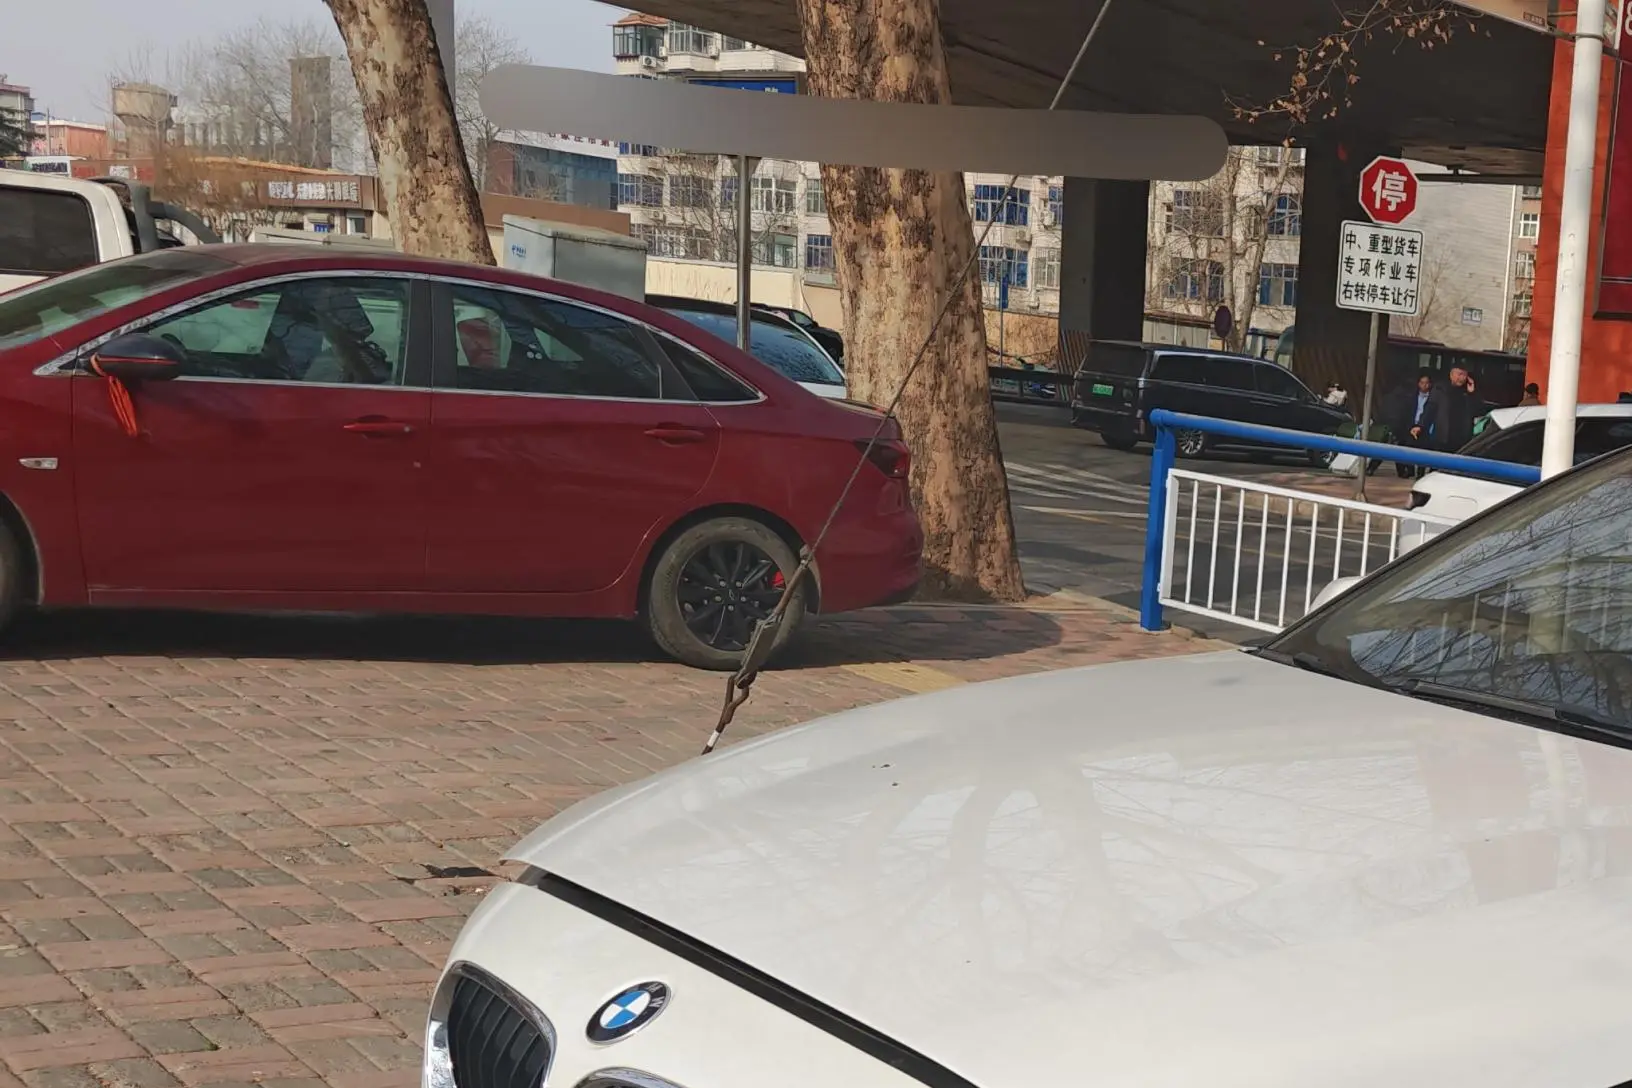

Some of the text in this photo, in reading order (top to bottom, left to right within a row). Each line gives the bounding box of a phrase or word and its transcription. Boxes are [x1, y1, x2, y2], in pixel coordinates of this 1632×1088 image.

[1371, 168, 1408, 212] 停
[1345, 230, 1419, 258] 中、重型货车
[1343, 255, 1418, 283] 专项作业车
[1341, 280, 1416, 308] 右转停车让行
